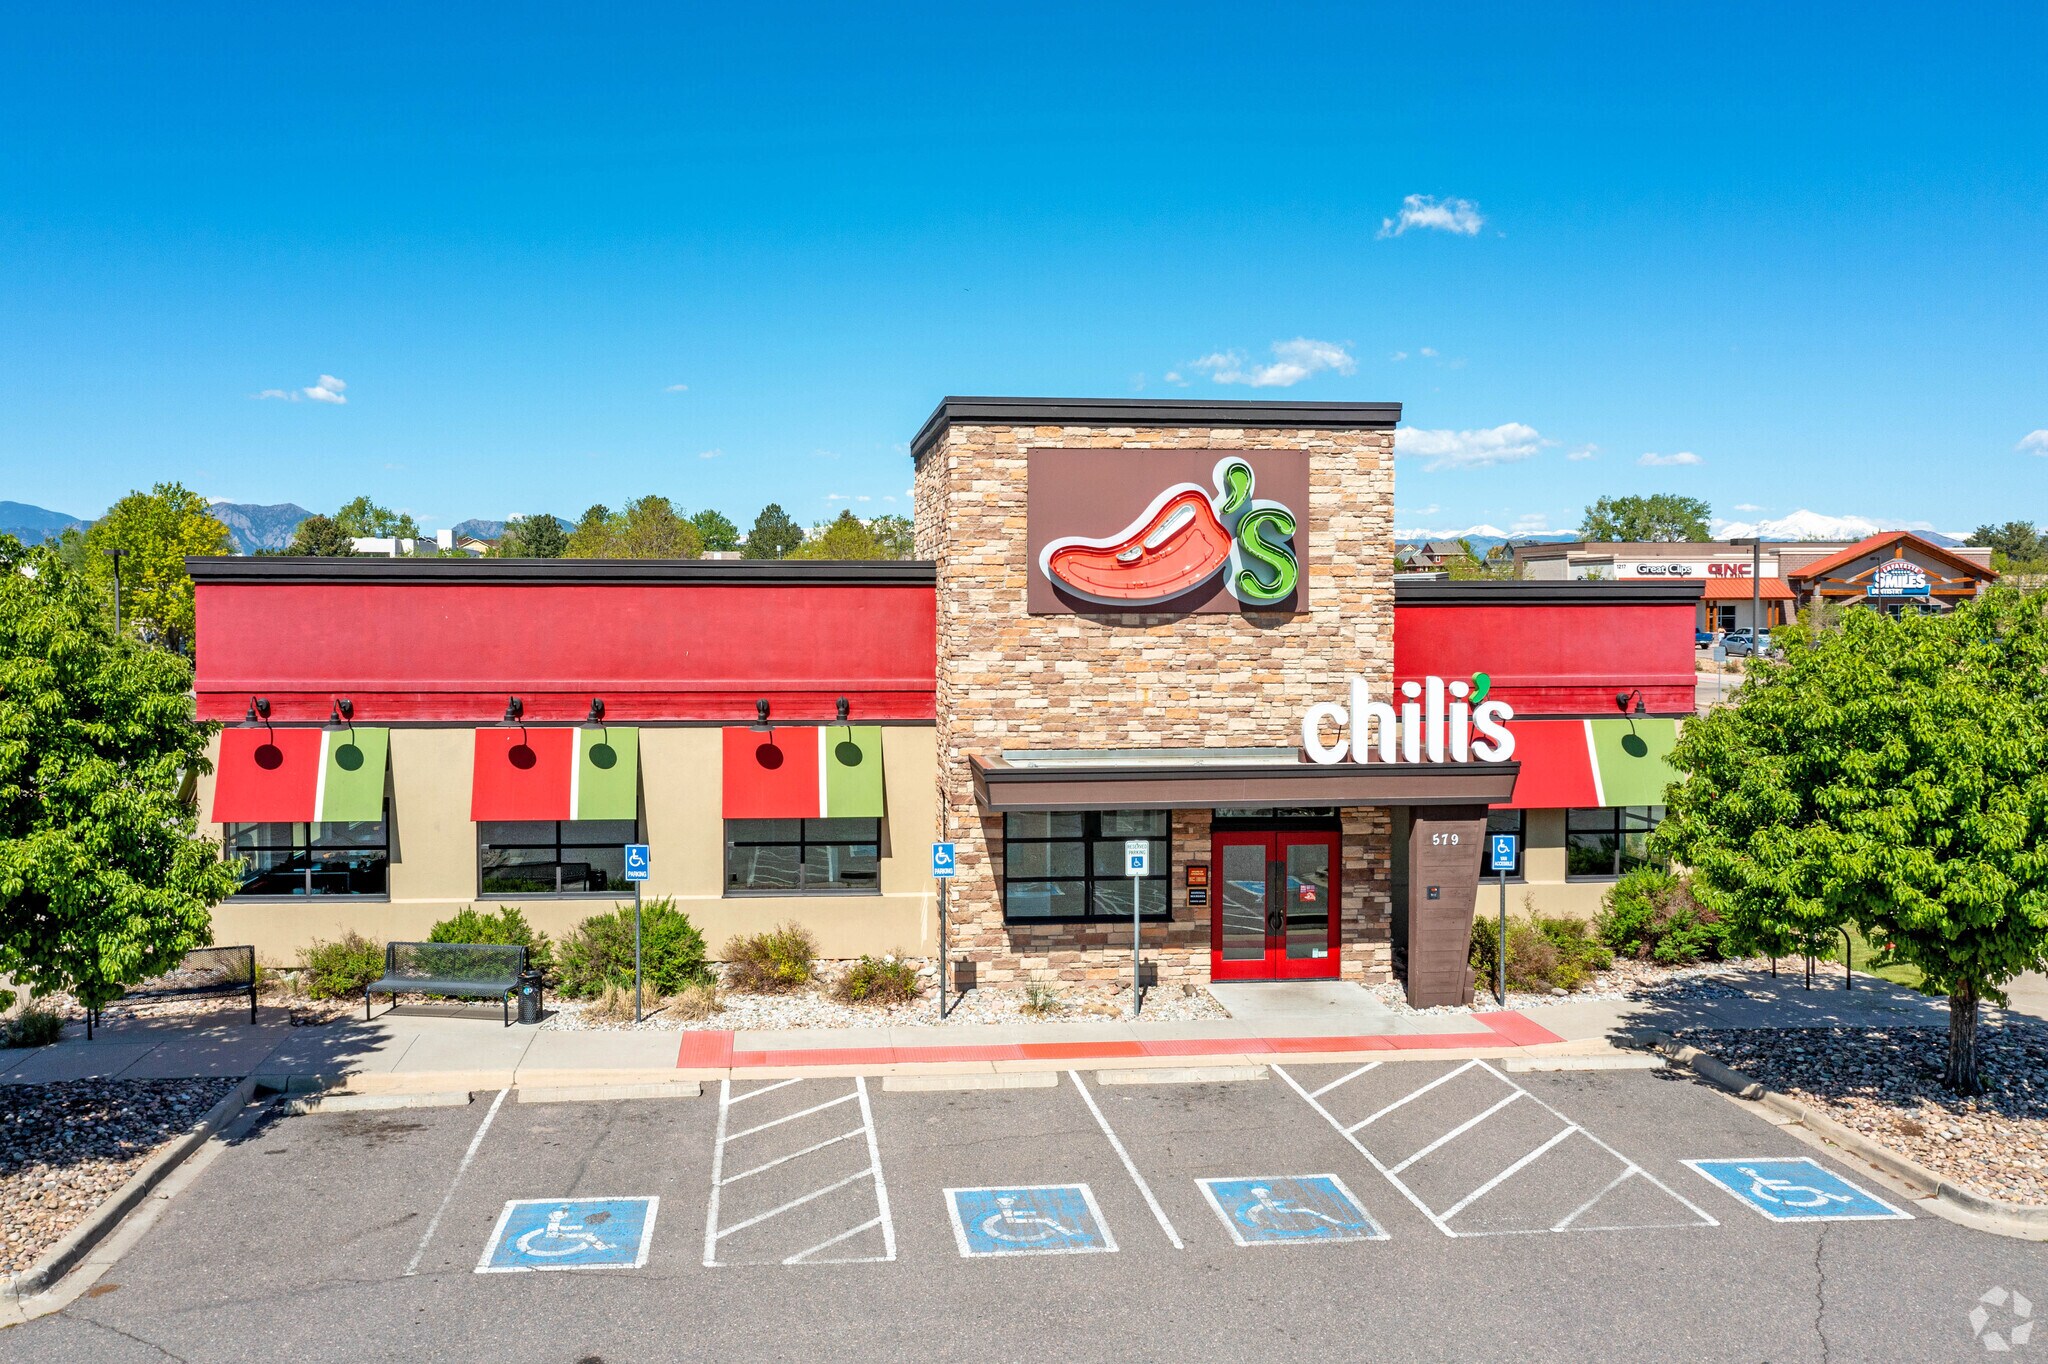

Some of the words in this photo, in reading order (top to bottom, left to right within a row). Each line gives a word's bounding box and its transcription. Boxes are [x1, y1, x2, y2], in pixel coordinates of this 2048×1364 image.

[1637, 563, 1667, 575] Great
[1668, 563, 1693, 578] Clips
[1708, 563, 1752, 575] GNC
[1882, 563, 1920, 573] LAFAYETTE
[1874, 572, 1926, 589] SMILES
[1302, 672, 1516, 764] chili's
[1432, 833, 1460, 846] 579
